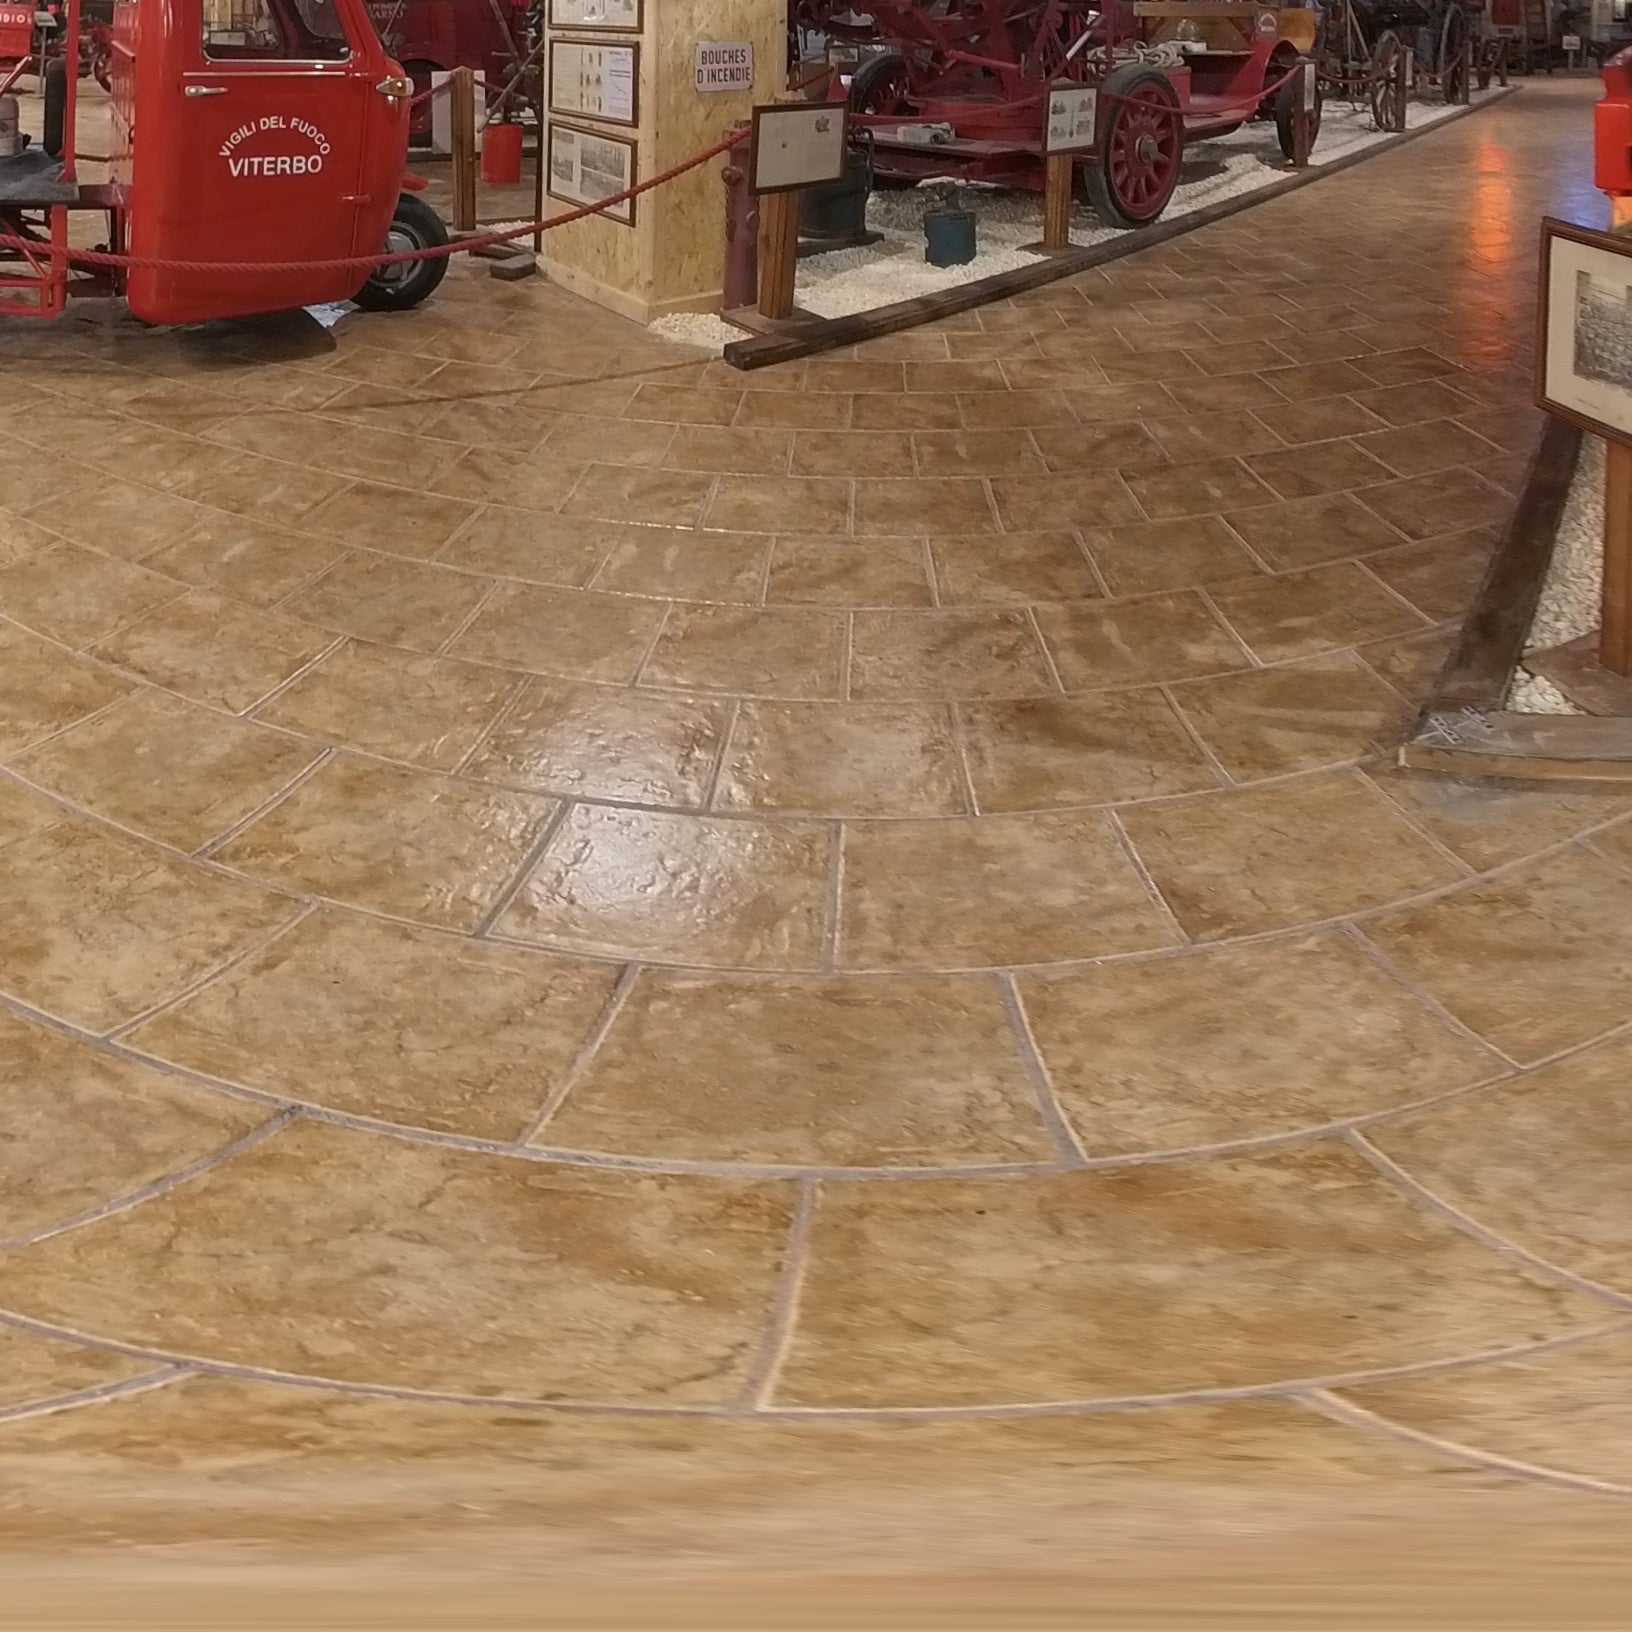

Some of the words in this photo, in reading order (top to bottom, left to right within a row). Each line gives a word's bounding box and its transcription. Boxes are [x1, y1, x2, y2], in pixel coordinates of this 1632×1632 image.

[700, 48, 747, 66] BOUCHES
[218, 121, 257, 157] VIGILI
[260, 115, 287, 131] DEL
[290, 117, 331, 155] FUOCO
[228, 155, 323, 177] VITERBO
